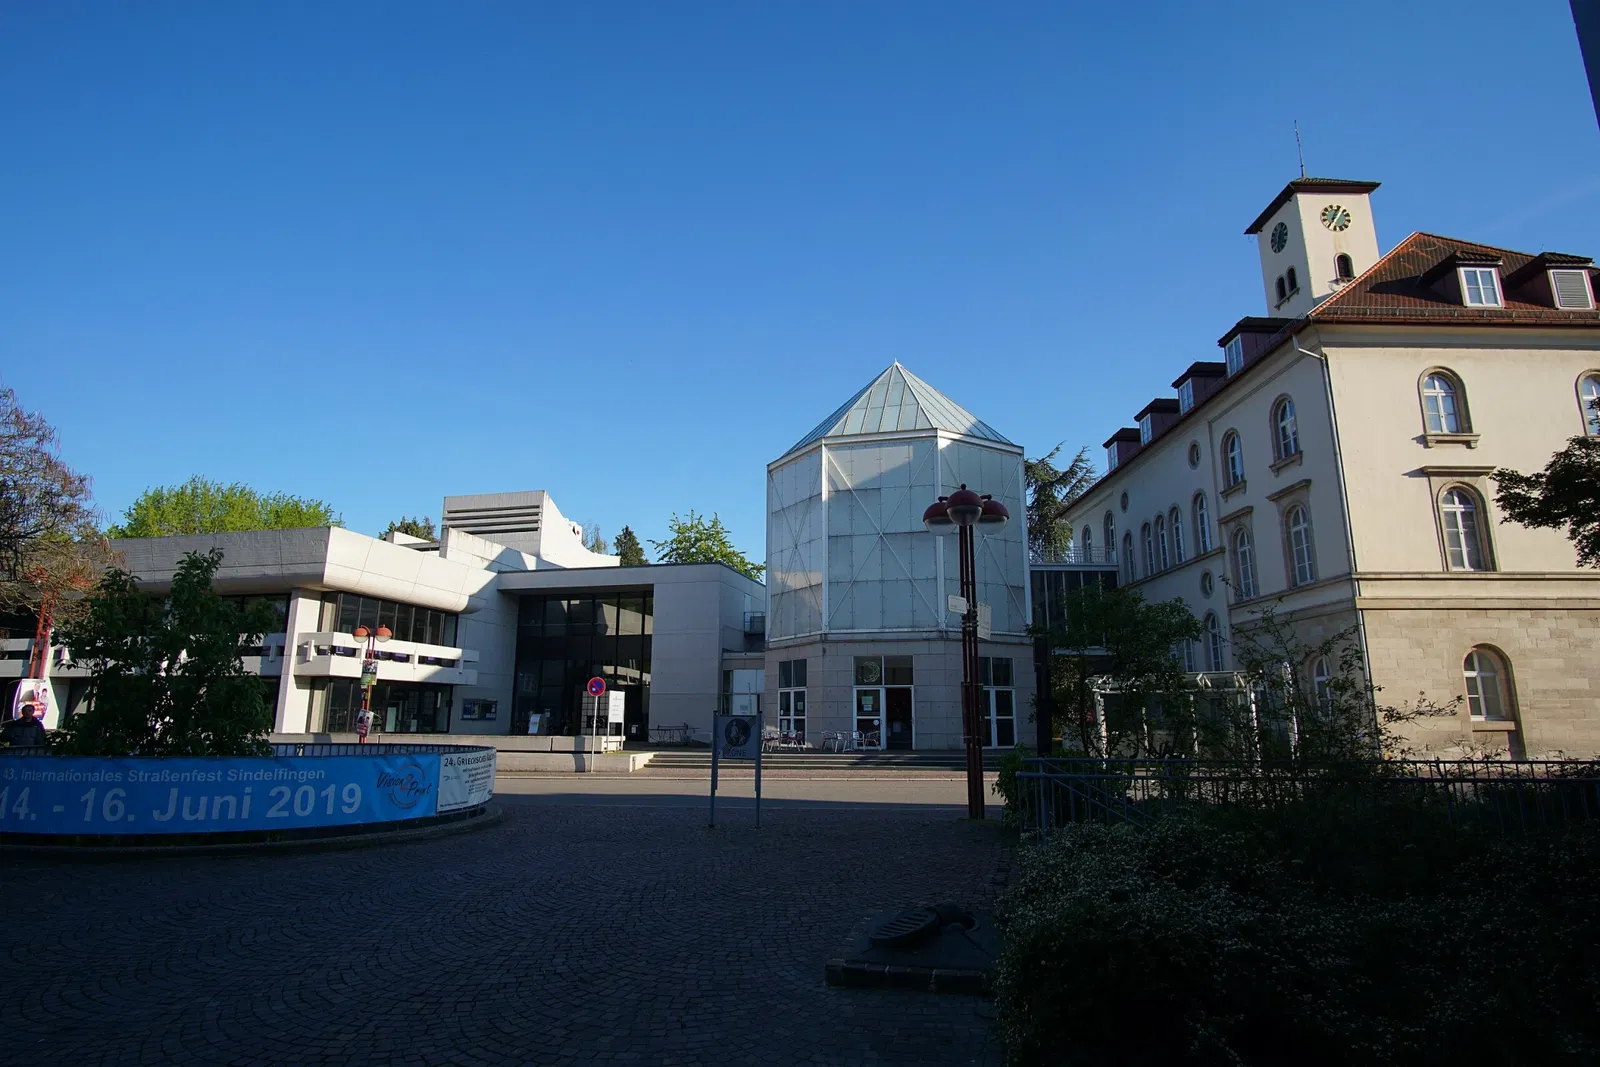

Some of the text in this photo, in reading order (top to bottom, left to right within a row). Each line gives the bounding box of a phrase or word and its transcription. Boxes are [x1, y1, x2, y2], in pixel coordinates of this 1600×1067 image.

[443, 757, 456, 767] 24.
[3, 767, 325, 783] 43. Internationales Straßenfest Sindelfingen
[376, 772, 404, 788] Vision
[407, 781, 433, 798] Print
[0, 786, 36, 821] 14.
[80, 788, 135, 822] 16.
[152, 786, 253, 822] Juni
[265, 783, 362, 818] 2019
